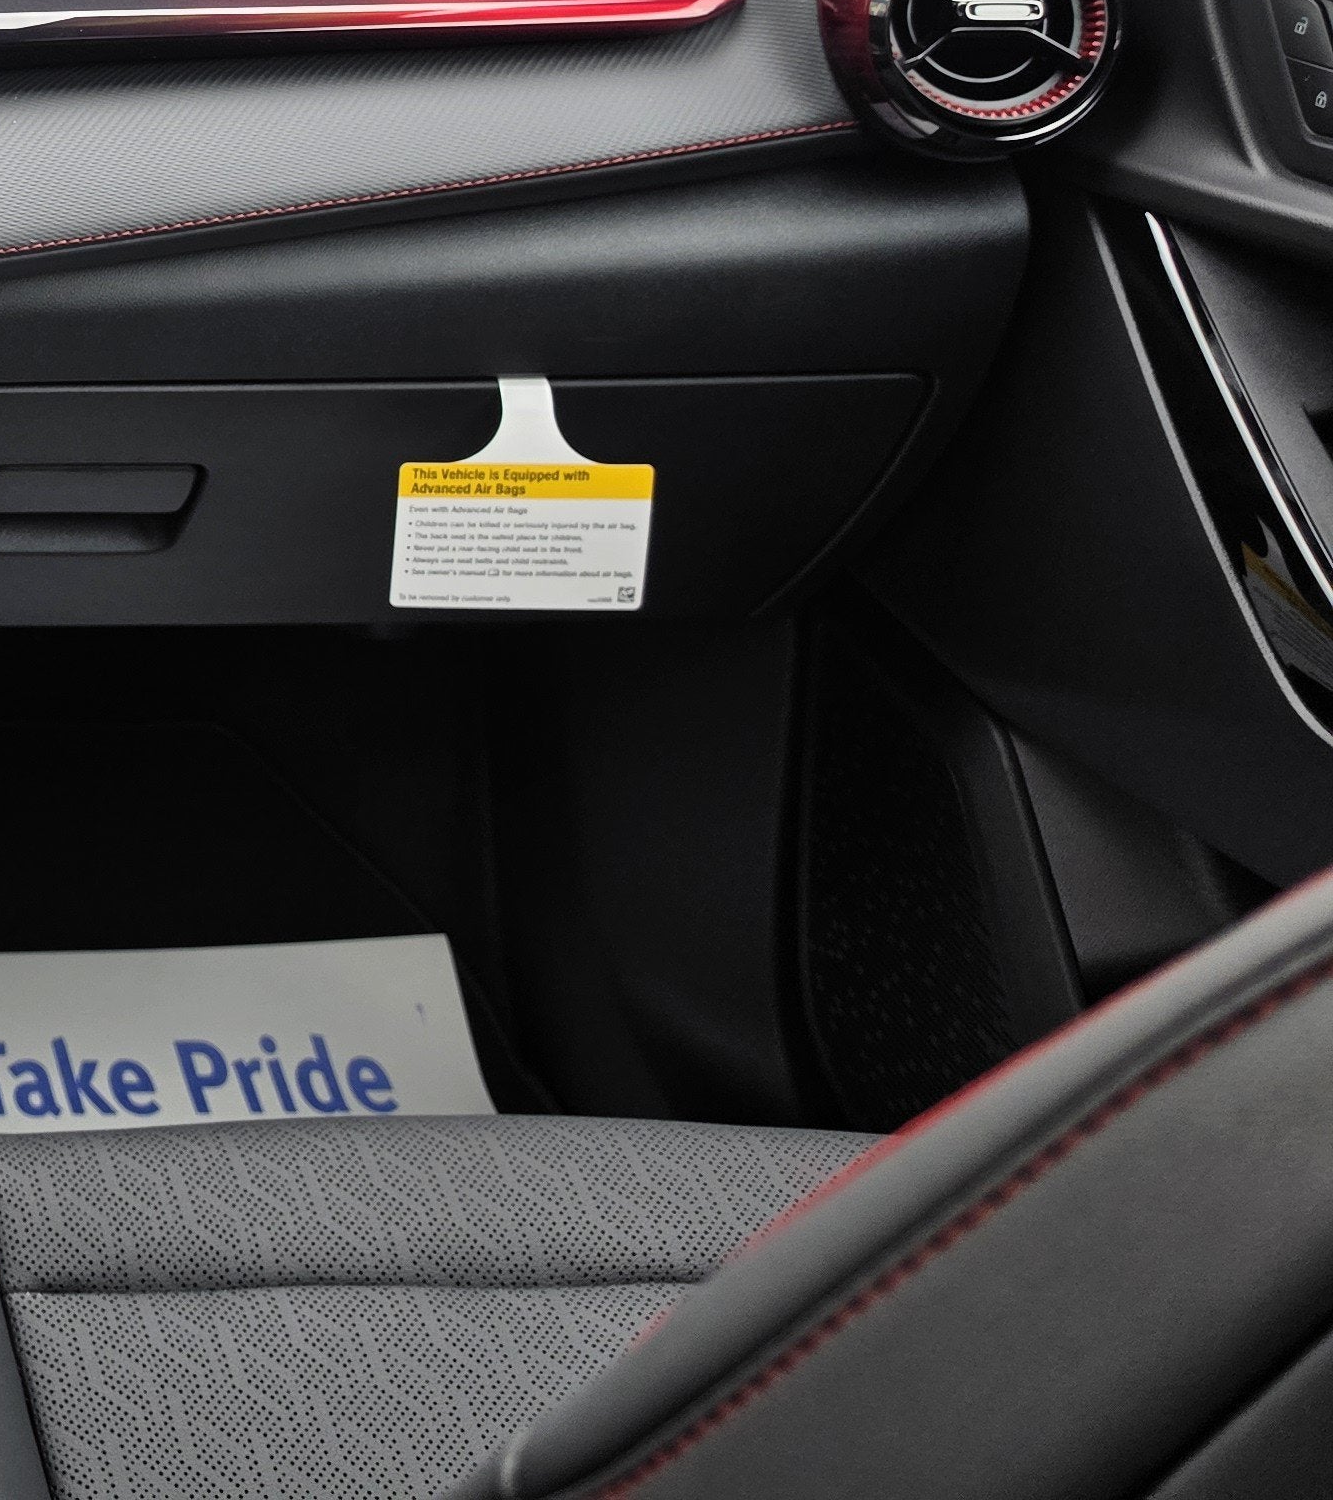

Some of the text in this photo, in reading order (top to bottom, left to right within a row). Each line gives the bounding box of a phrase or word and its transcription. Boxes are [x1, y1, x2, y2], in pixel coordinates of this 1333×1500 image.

[413, 468, 437, 479] This
[442, 469, 485, 480] Vehicle
[504, 469, 559, 482] Equipped
[563, 470, 590, 480] with
[411, 483, 526, 496] Advanced Air Bags
[174, 1034, 398, 1115] Pride
